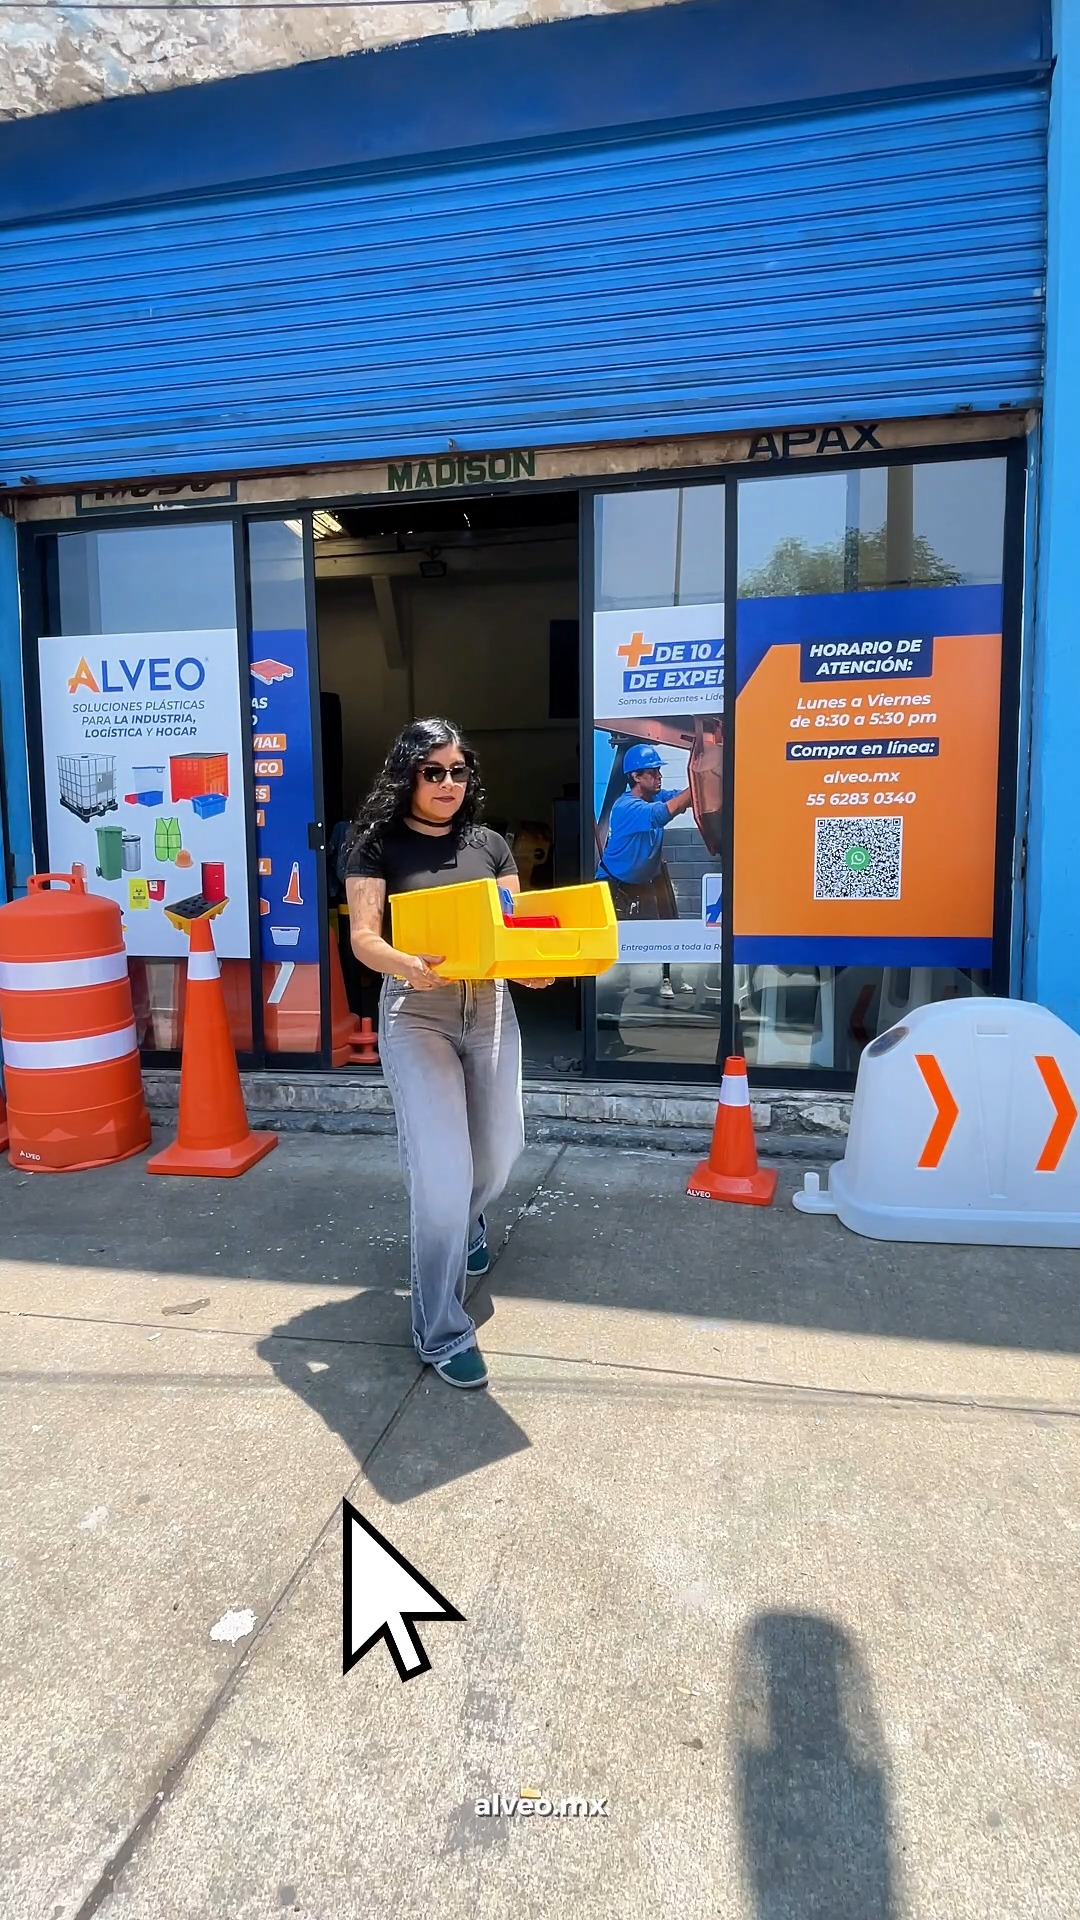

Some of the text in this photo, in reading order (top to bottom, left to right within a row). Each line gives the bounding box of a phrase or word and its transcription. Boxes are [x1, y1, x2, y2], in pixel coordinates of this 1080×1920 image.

[747, 424, 884, 462] APAX
[387, 450, 536, 491] MADISON
[655, 645, 685, 662] DE
[690, 643, 712, 660] 10
[809, 639, 923, 658] HORARIO DE
[67, 655, 206, 694] ALVEO
[815, 656, 914, 676] ATENCIÓN:
[629, 672, 659, 690] DE
[72, 699, 205, 713] SOLUCIONES PLÁSTICAS
[618, 697, 647, 706] Somos
[649, 694, 699, 705] fabricantes
[796, 693, 932, 710] Lunes a Viernes
[82, 713, 196, 726] PARA LA INDUSTRIA,
[789, 711, 938, 728] de 8:30 a 5:30 pm
[84, 726, 198, 739] LOGÍSTICA Y HOGAR
[790, 740, 936, 759] Compra en línea:
[823, 770, 901, 784] alveo.mx
[806, 791, 917, 806] 55 6283 0340
[621, 944, 672, 953] Entregamos
[681, 943, 701, 951] toda
[703, 943, 712, 951] la
[20, 1150, 41, 1161] ALVEO
[686, 1188, 711, 1199] ALVEO
